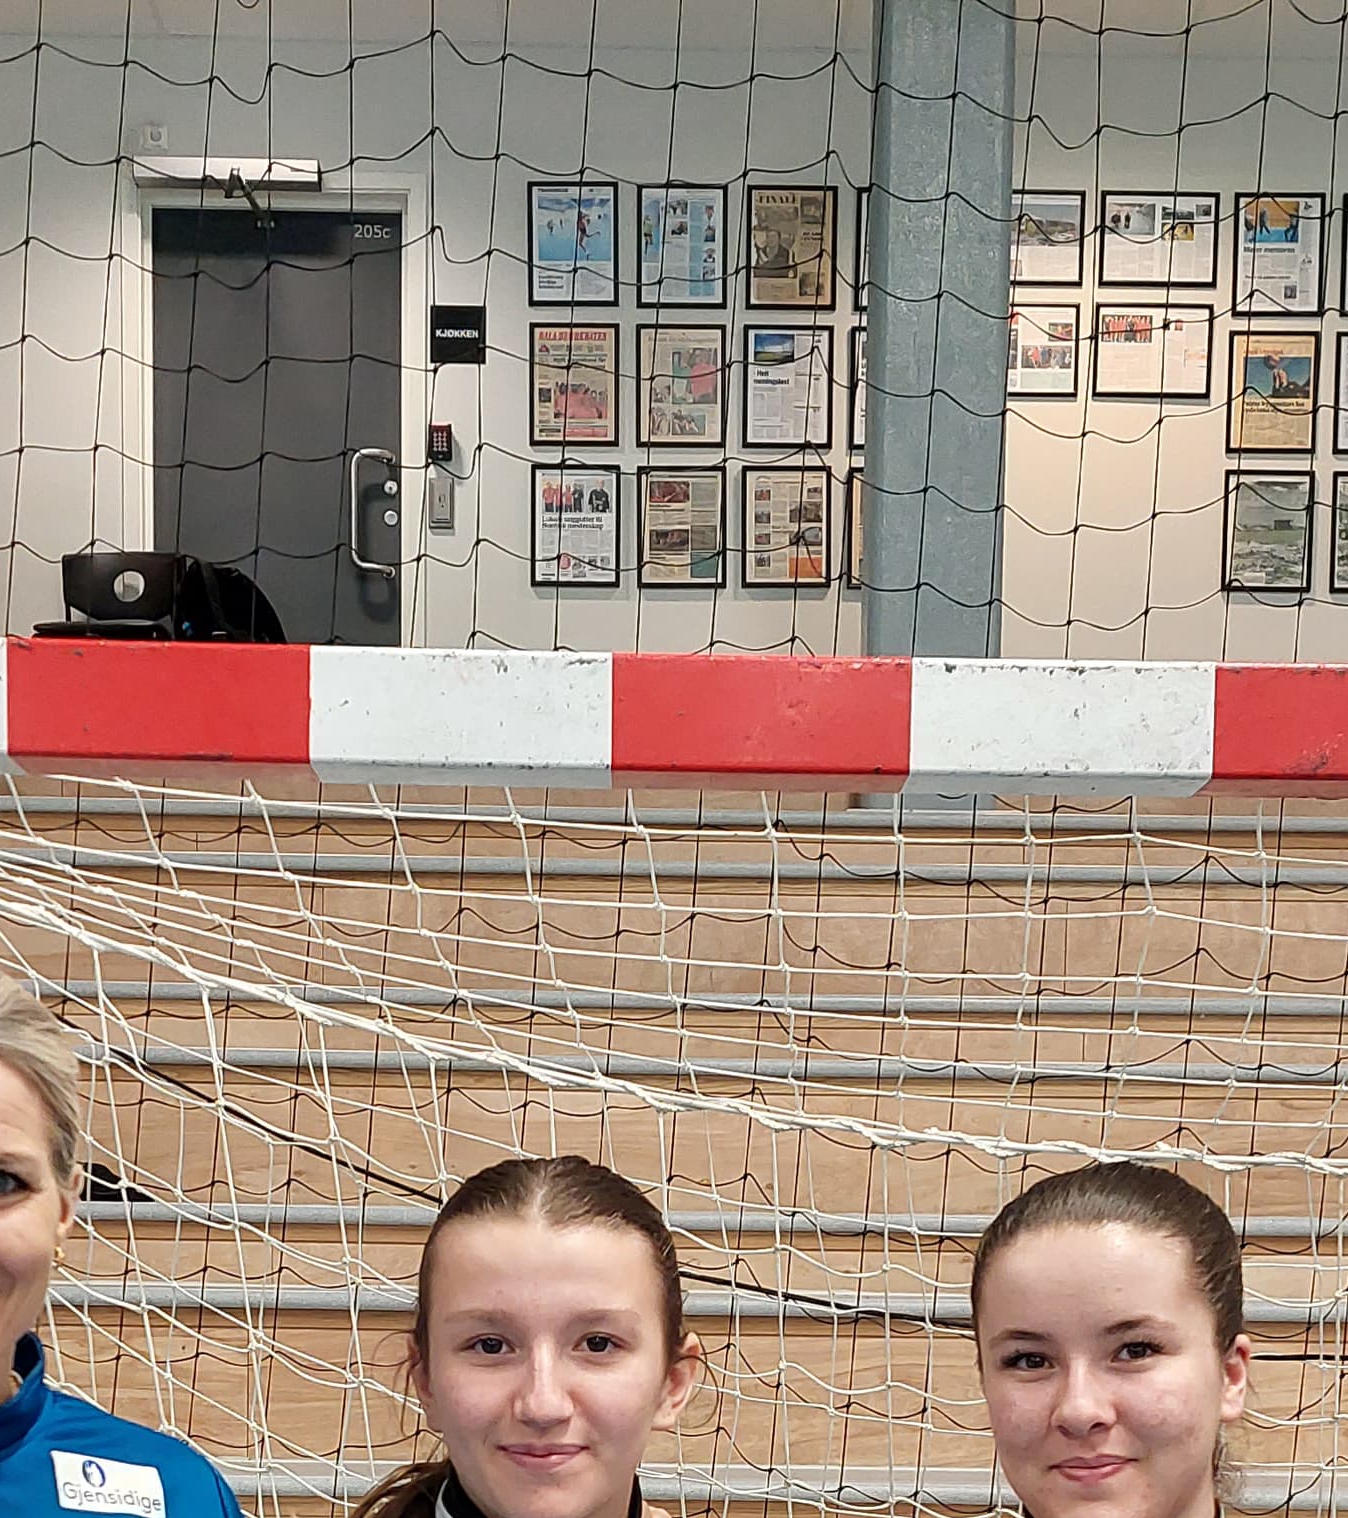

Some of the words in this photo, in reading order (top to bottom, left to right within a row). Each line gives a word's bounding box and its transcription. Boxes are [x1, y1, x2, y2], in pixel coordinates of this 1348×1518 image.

[354, 224, 391, 238] 205c
[435, 329, 479, 339] KJØKKEN
[62, 1481, 162, 1514] Gjensidige
